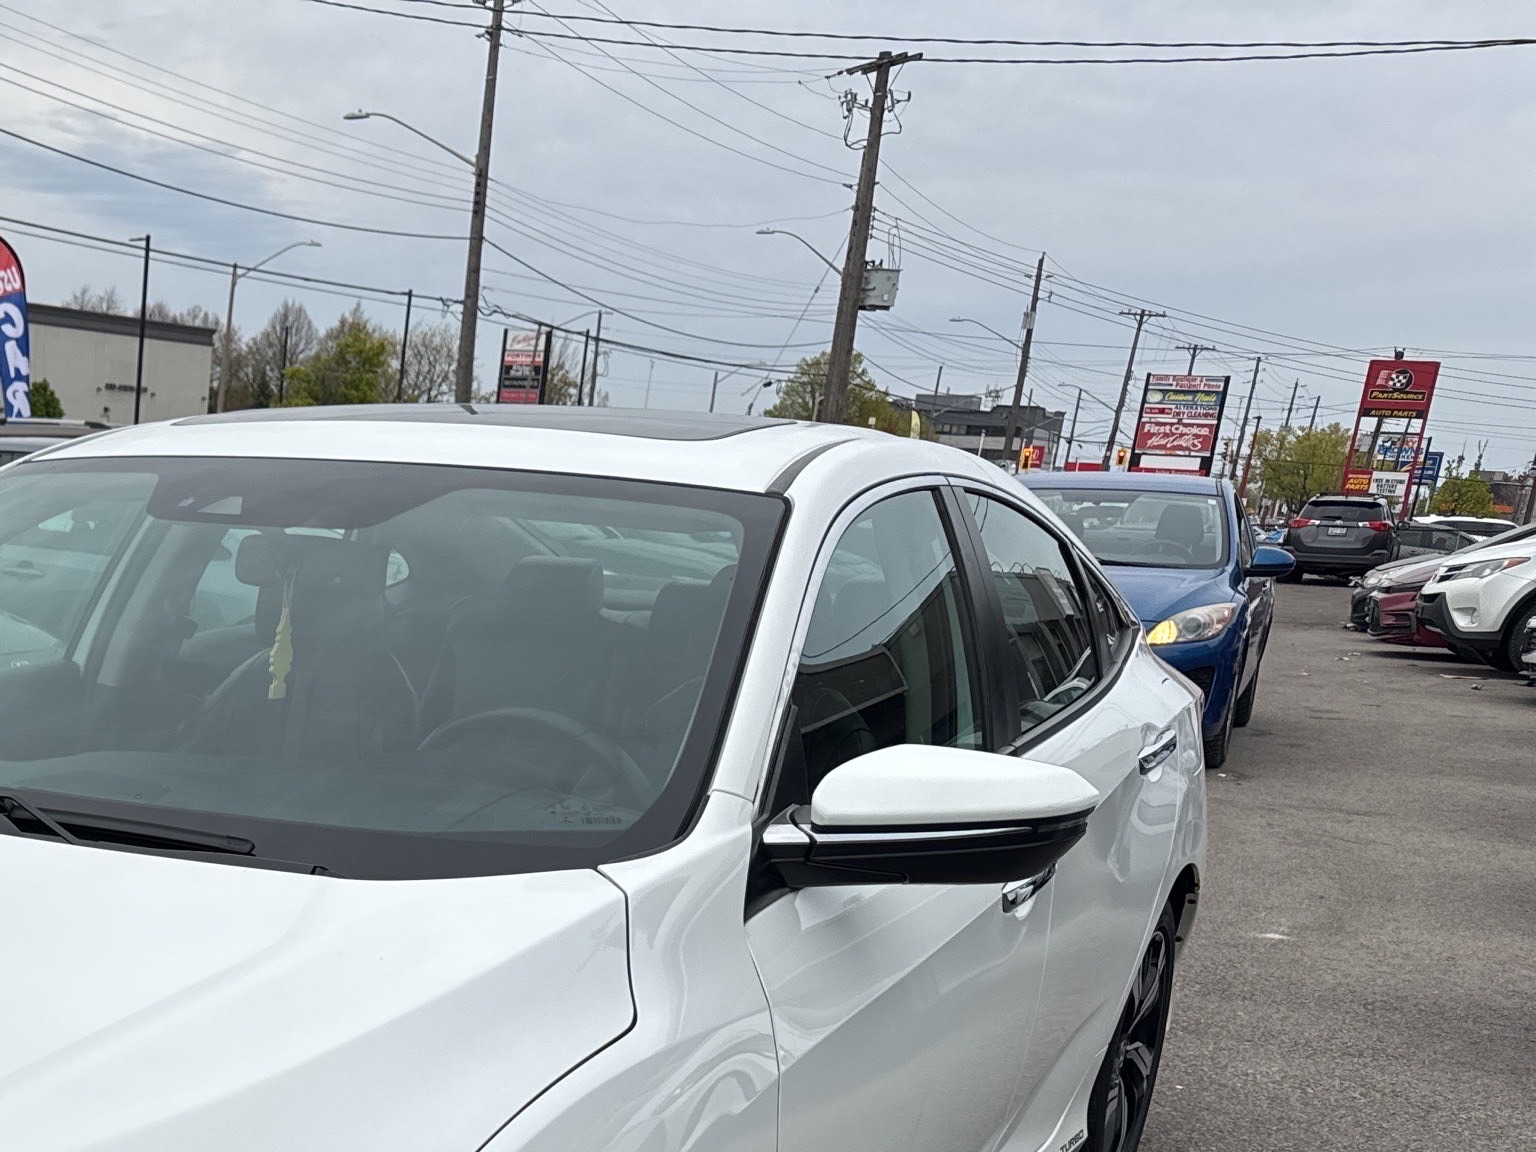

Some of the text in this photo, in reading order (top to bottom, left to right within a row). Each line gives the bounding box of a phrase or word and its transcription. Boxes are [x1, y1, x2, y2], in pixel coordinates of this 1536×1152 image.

[1186, 411, 1217, 419] CLEANING
[1144, 423, 1210, 435] First Choice
